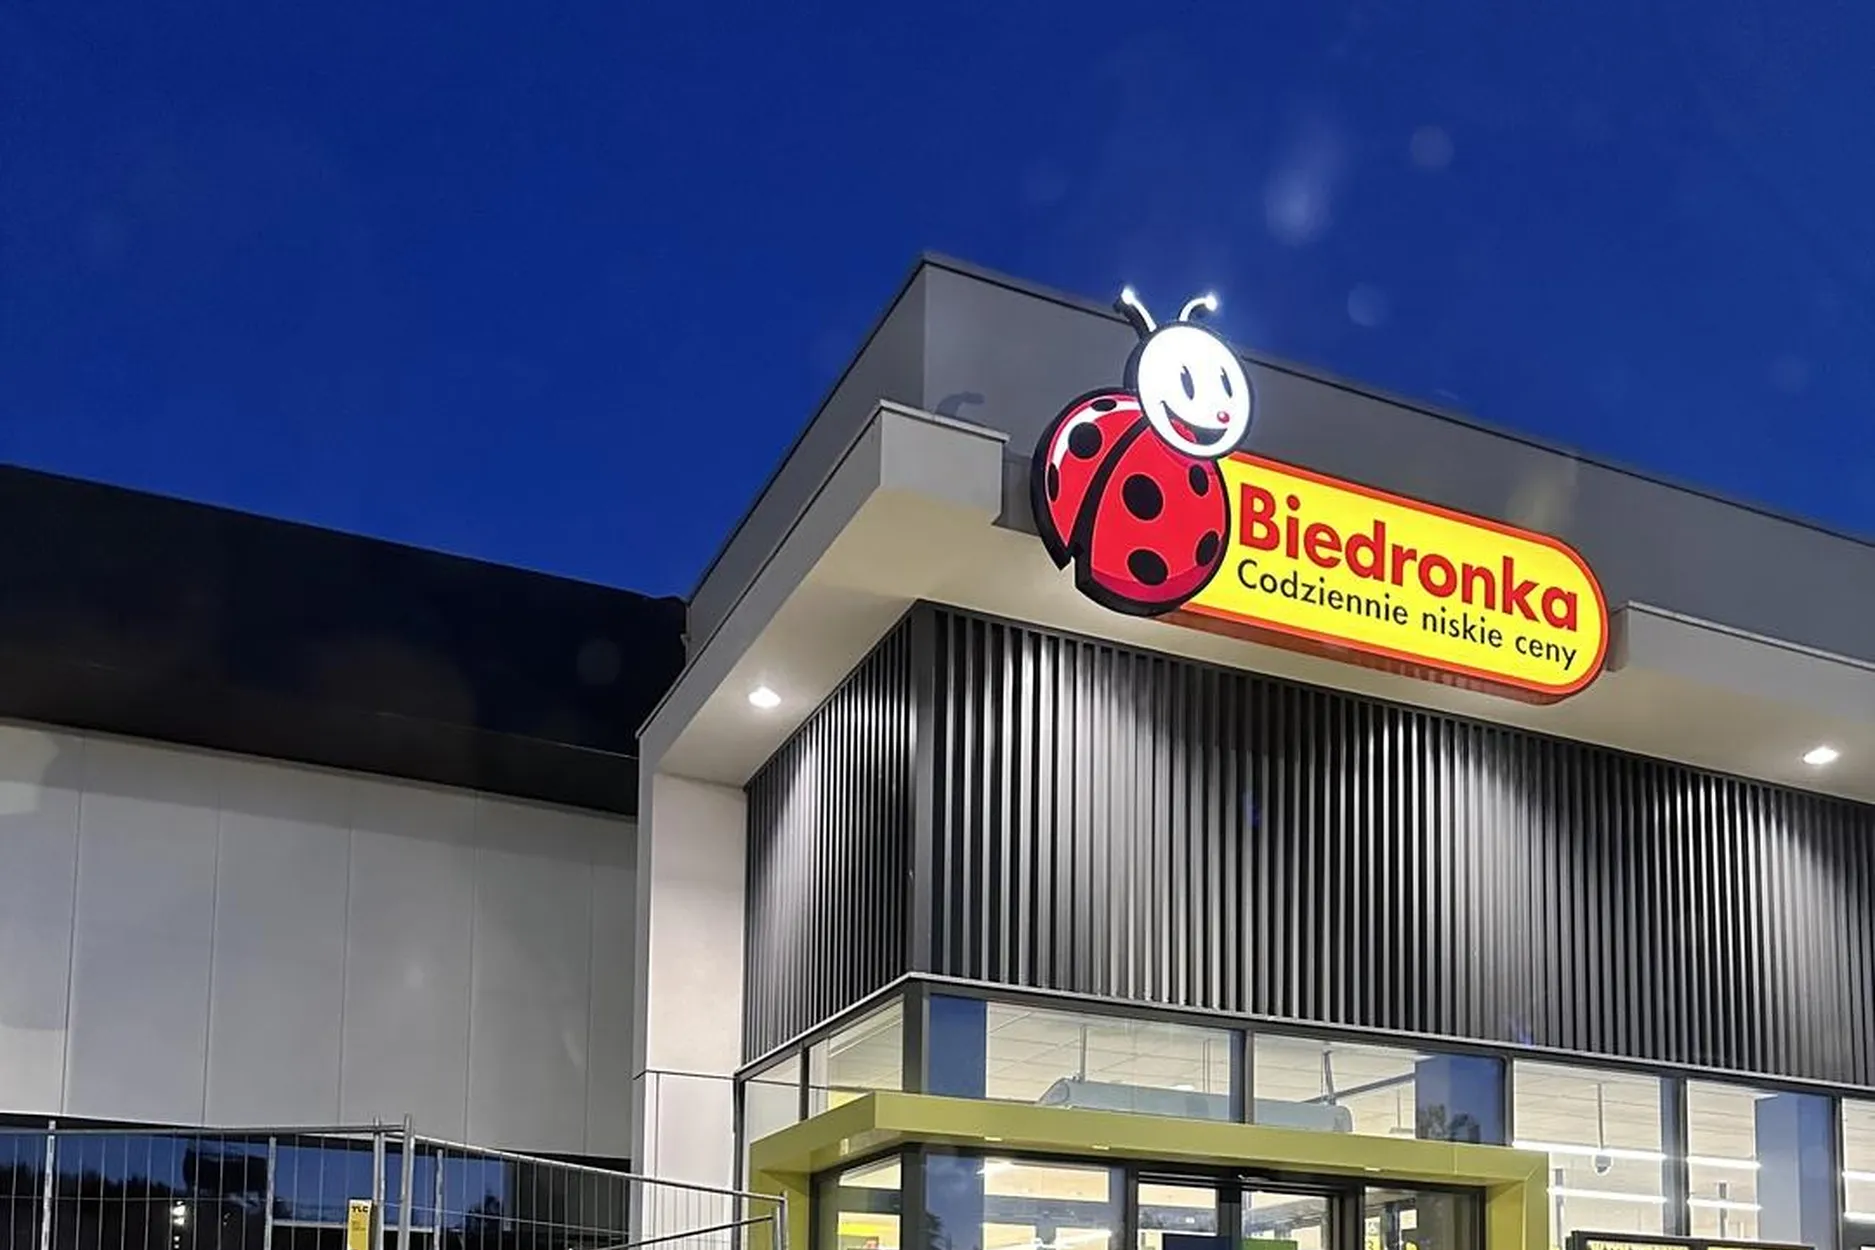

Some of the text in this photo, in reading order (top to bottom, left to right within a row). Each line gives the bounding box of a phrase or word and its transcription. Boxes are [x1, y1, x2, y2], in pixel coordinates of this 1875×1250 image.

[1237, 560, 1578, 671] Codziennie niskie ceny
[1239, 481, 1578, 633] Biedronka
